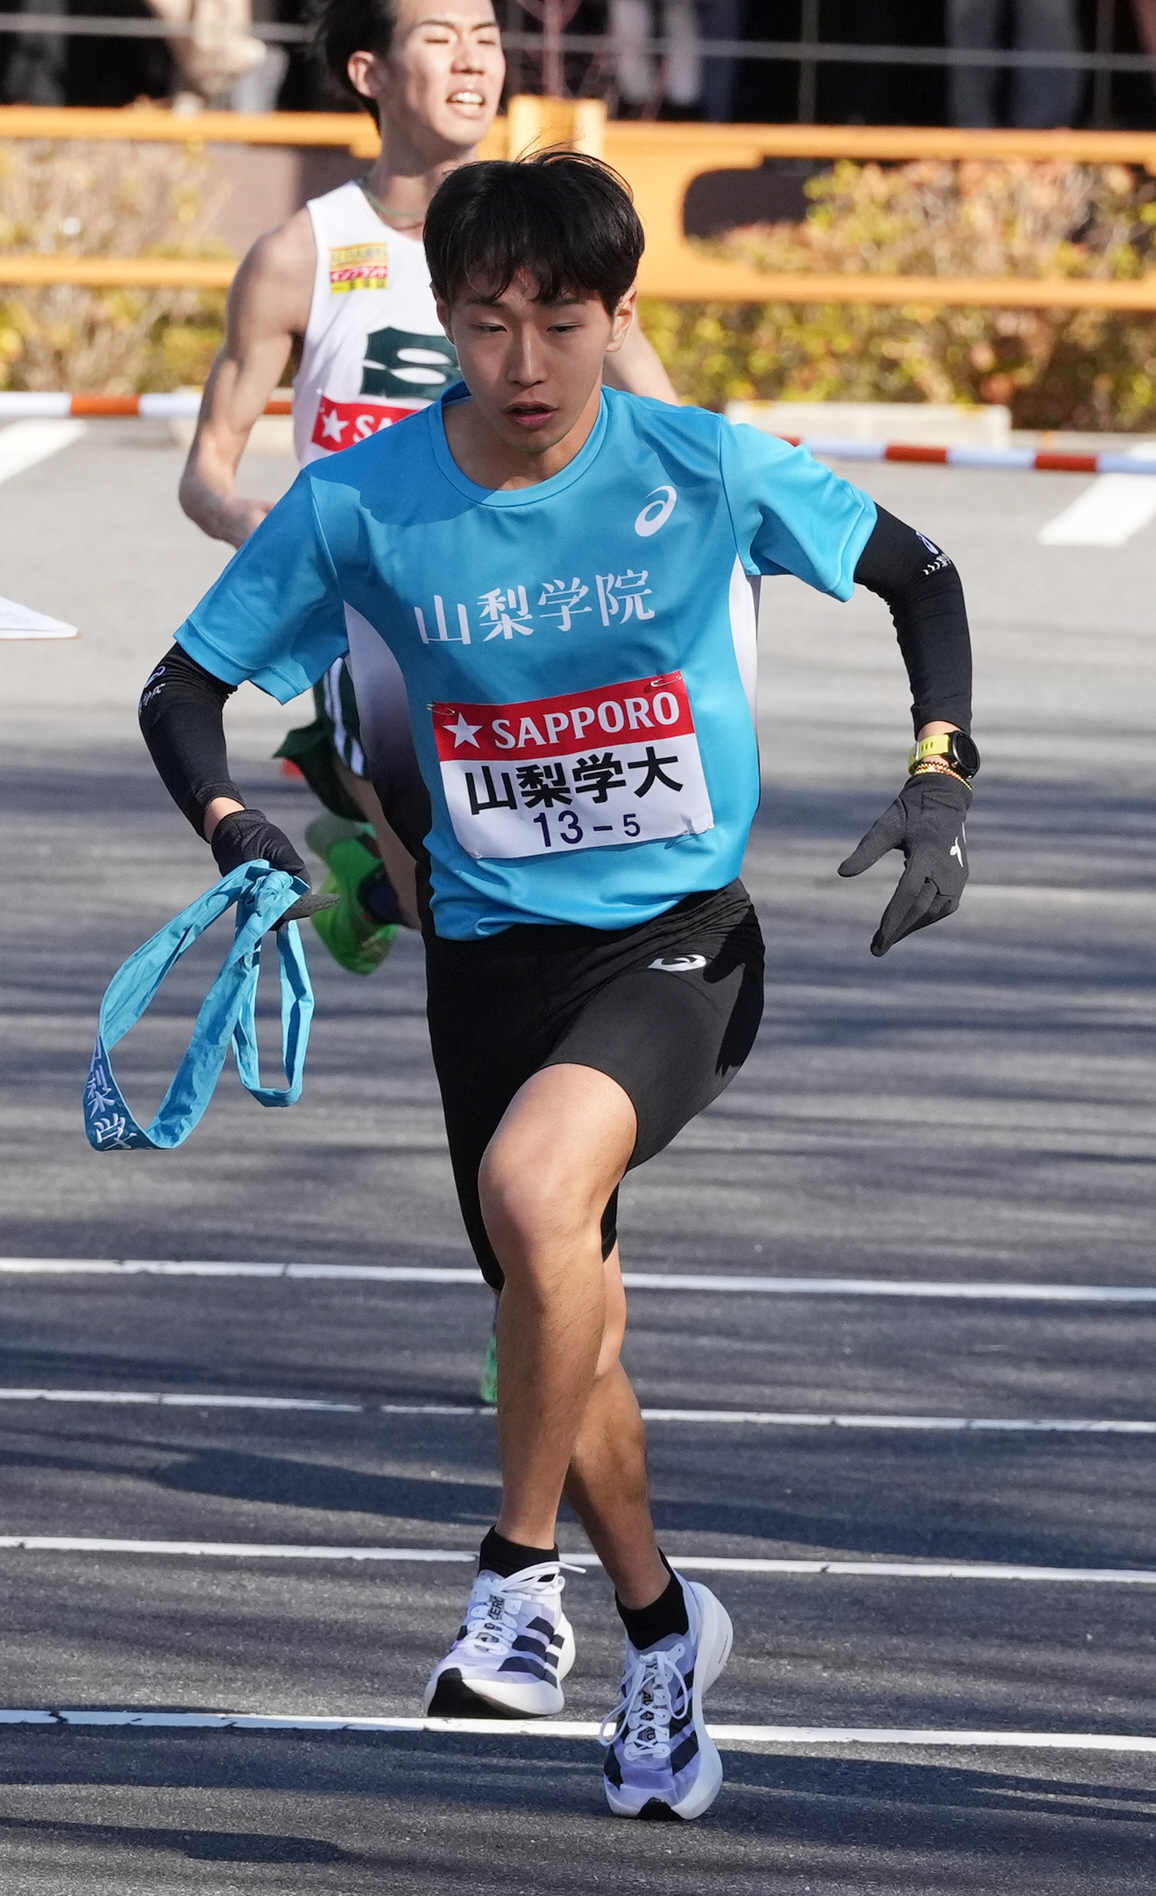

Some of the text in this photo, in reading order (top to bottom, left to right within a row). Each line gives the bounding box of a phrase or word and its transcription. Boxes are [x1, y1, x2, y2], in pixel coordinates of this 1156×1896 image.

[414, 569, 655, 645] 山梨学院
[491, 692, 680, 749] SAPPORO
[464, 747, 683, 815] 山梨学大
